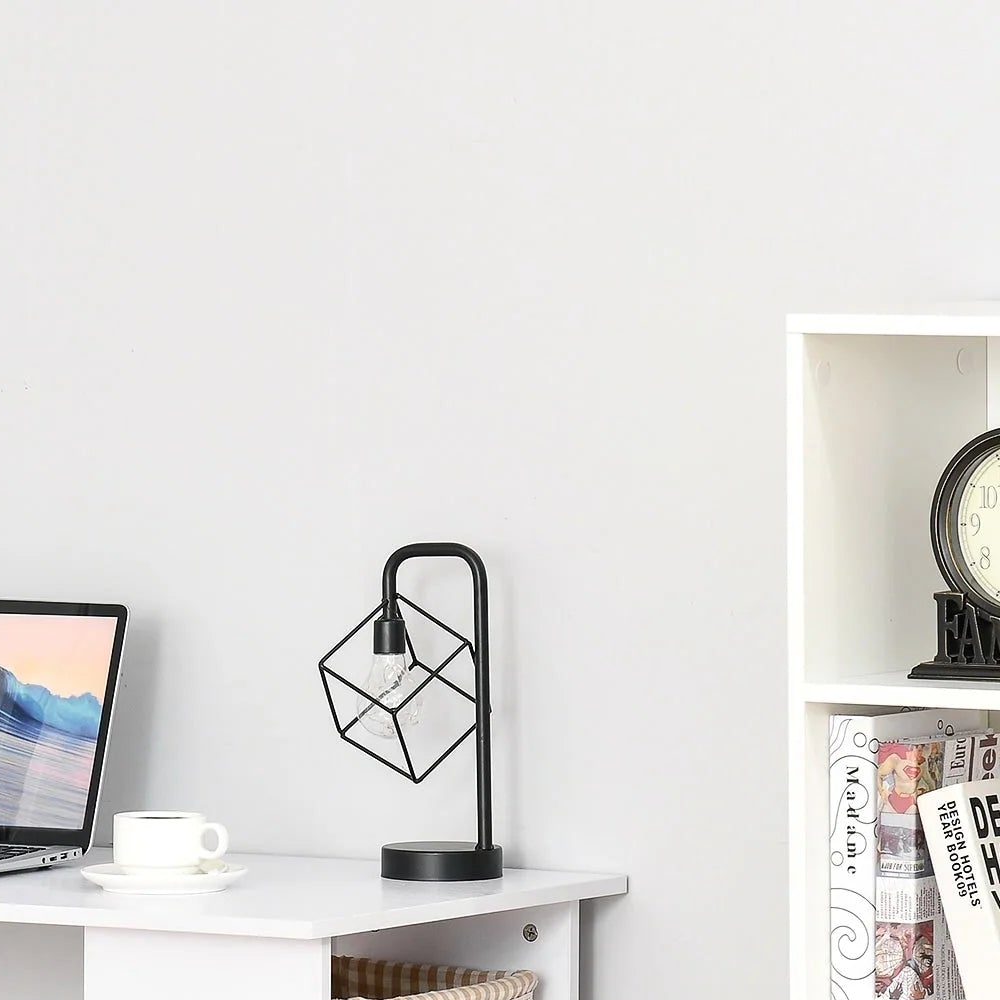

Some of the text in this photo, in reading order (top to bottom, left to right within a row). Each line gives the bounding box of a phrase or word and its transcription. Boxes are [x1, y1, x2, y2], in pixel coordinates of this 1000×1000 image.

[979, 485, 998, 509] 10
[970, 513, 981, 537] 9
[980, 546, 991, 570] 8
[846, 766, 860, 874] Madame
[937, 803, 953, 840] YEAR
[946, 800, 981, 907] DESIGN HOTELS
